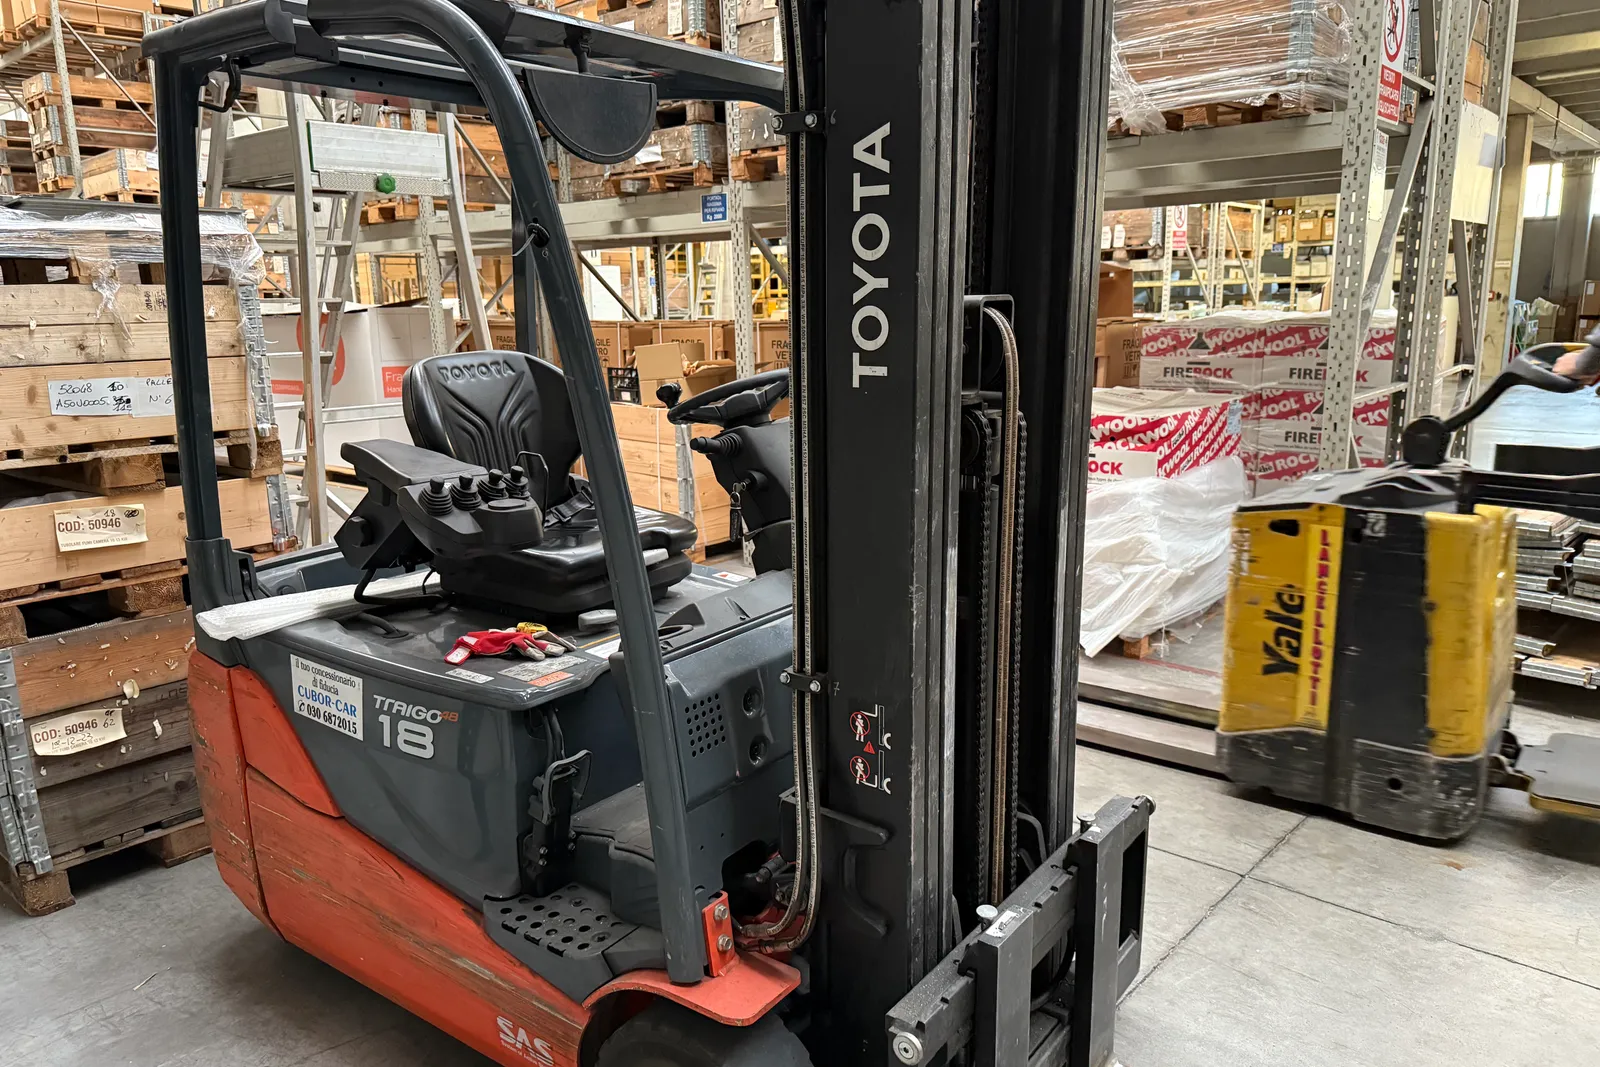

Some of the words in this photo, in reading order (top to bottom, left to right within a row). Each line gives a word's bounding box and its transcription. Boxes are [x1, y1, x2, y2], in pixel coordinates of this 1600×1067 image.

[851, 121, 891, 388] TOYOTA
[437, 360, 516, 384] TOYOTA
[1163, 366, 1234, 379] FIREROCK
[58, 382, 92, 395] 52048
[57, 520, 85, 533] COD:
[88, 517, 121, 531] 50946
[1262, 583, 1306, 677] Yale
[301, 661, 310, 672] tuo
[311, 666, 356, 688] concessionario
[312, 676, 318, 688] di
[319, 679, 339, 695] fiducia
[297, 684, 357, 718] CUBOR-CAR
[34, 728, 62, 744] COD:
[65, 718, 98, 736] 50946
[306, 703, 321, 720] 030
[323, 710, 357, 735] 6872015
[378, 714, 435, 759] 18
[496, 1015, 554, 1067] SAS
